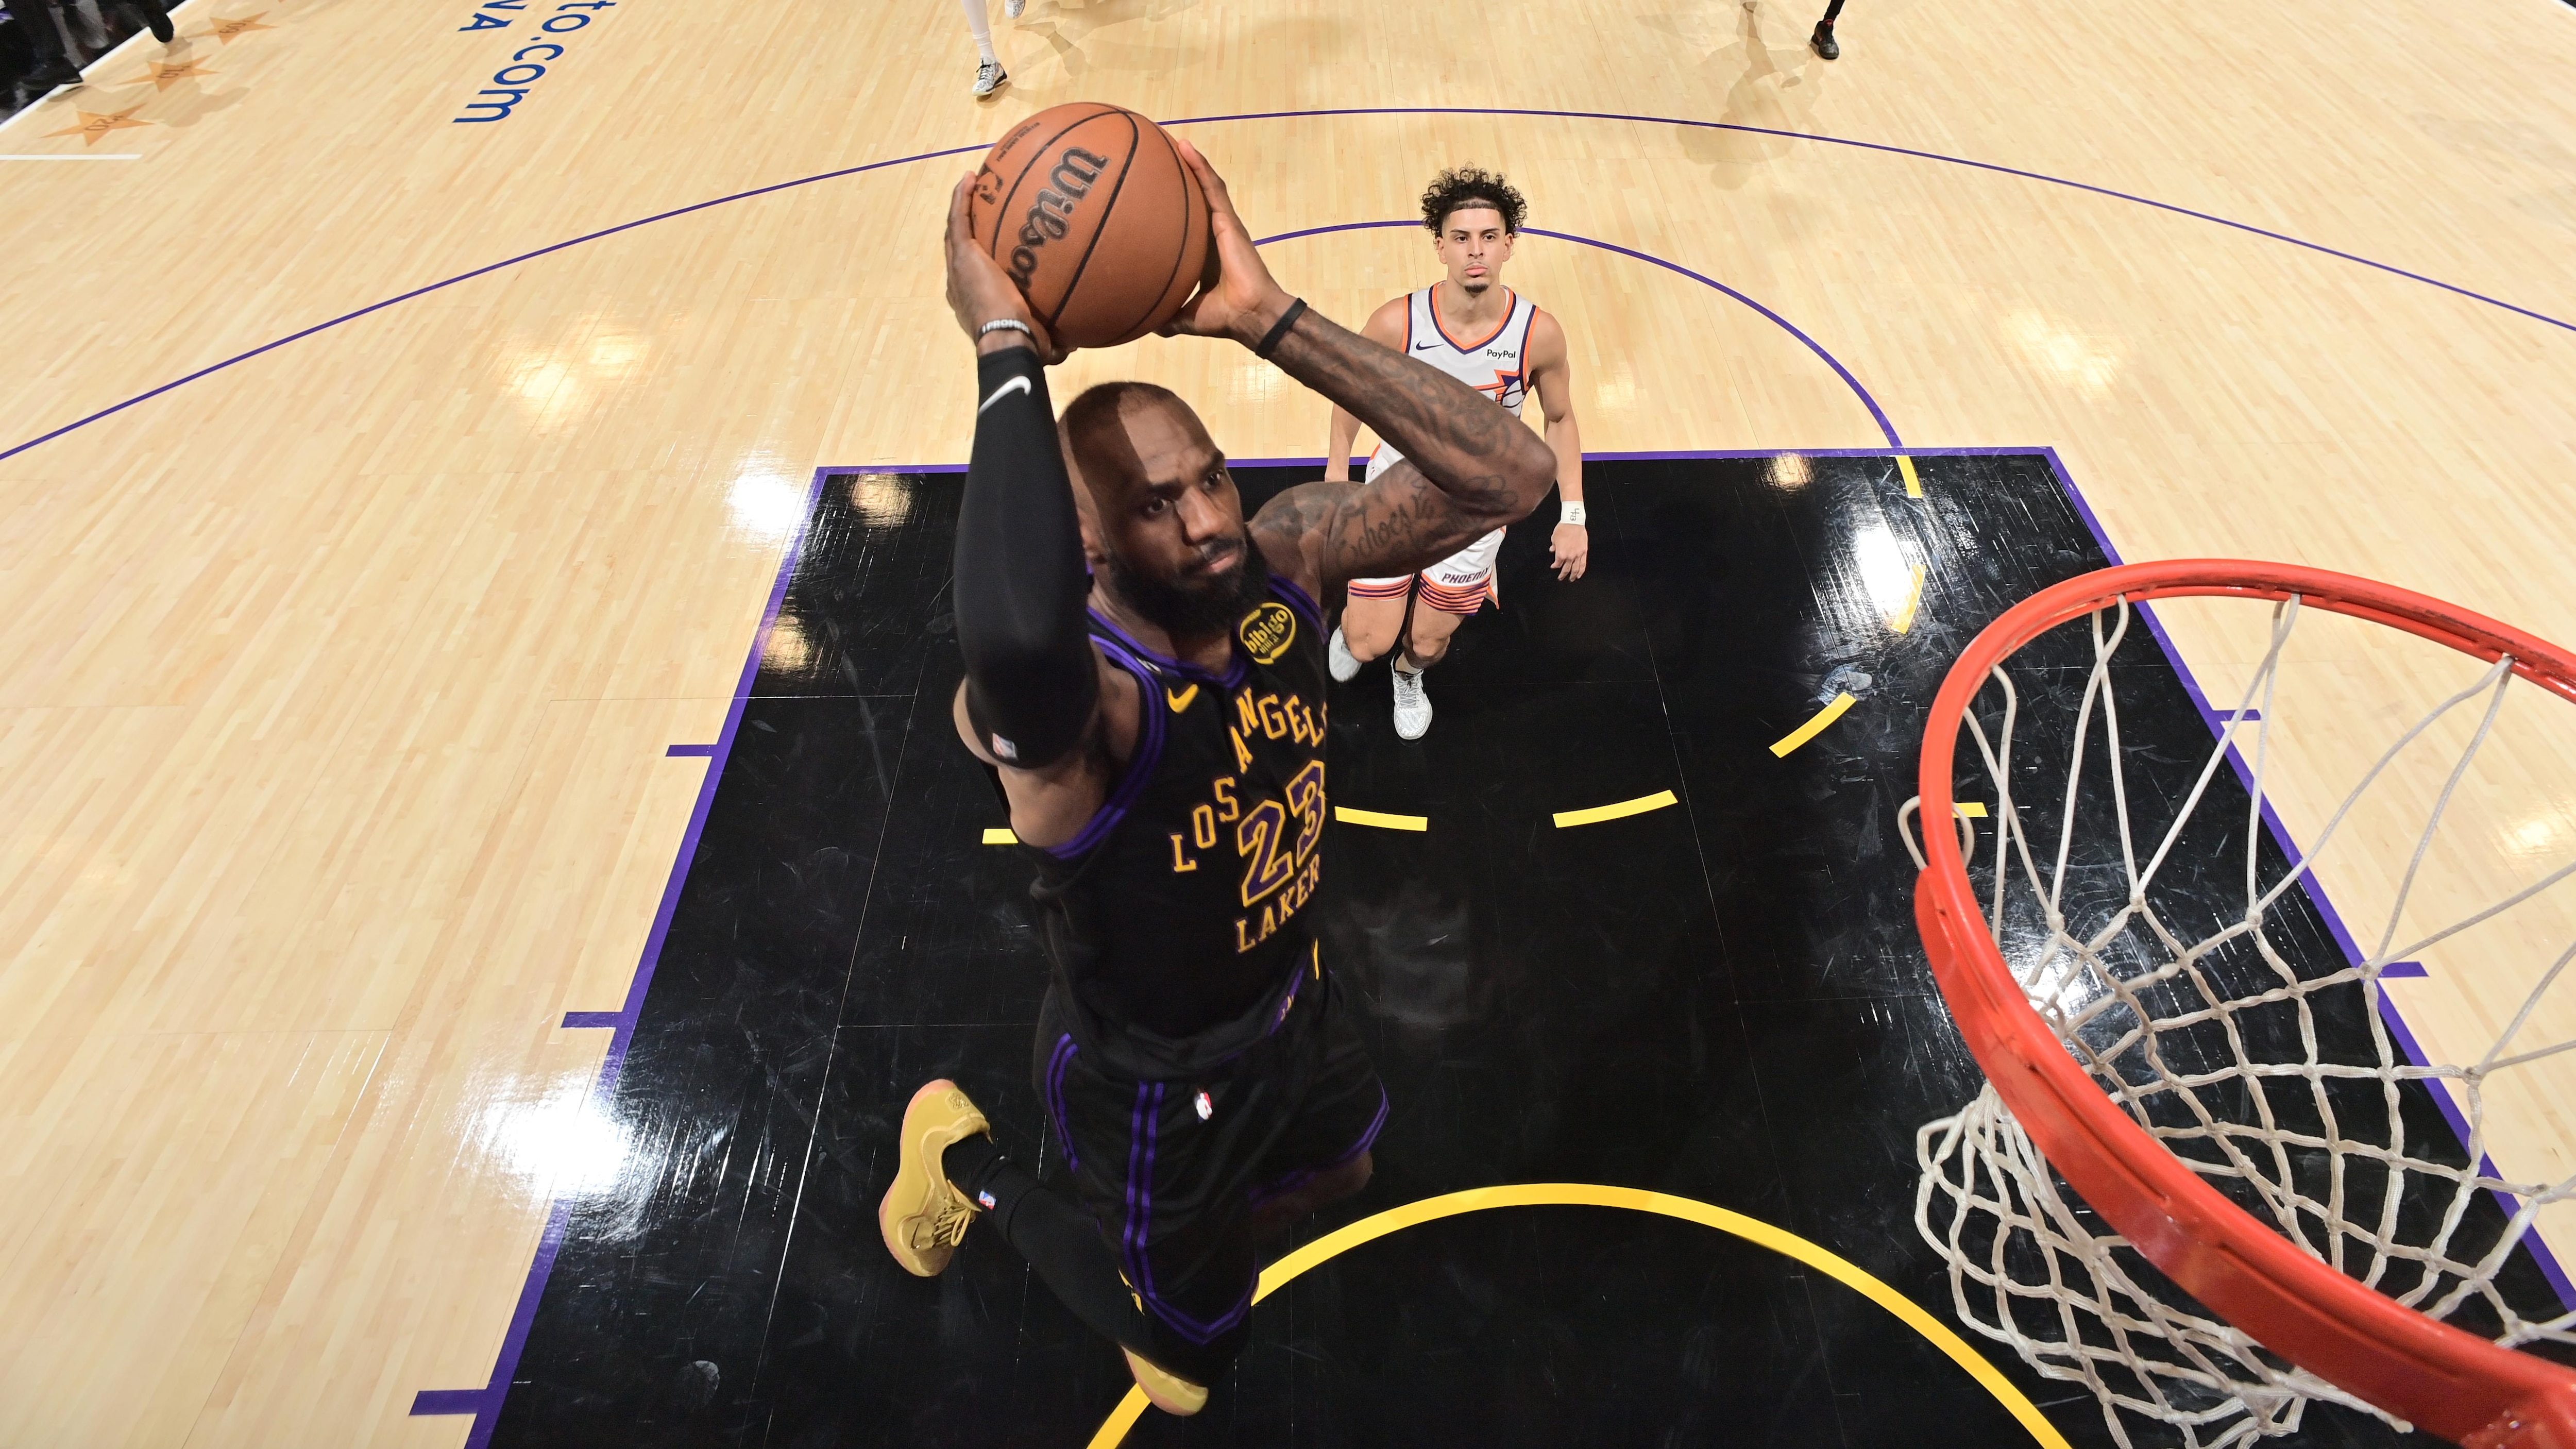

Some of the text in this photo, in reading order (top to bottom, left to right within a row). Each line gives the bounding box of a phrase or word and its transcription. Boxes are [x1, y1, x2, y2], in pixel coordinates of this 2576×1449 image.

[1487, 349, 1516, 360] PayPal
[1441, 564, 1491, 584] PHOENIX
[1244, 610, 1288, 654] bibigo
[1170, 777, 1239, 872] LOS
[1237, 760, 1327, 907] 23
